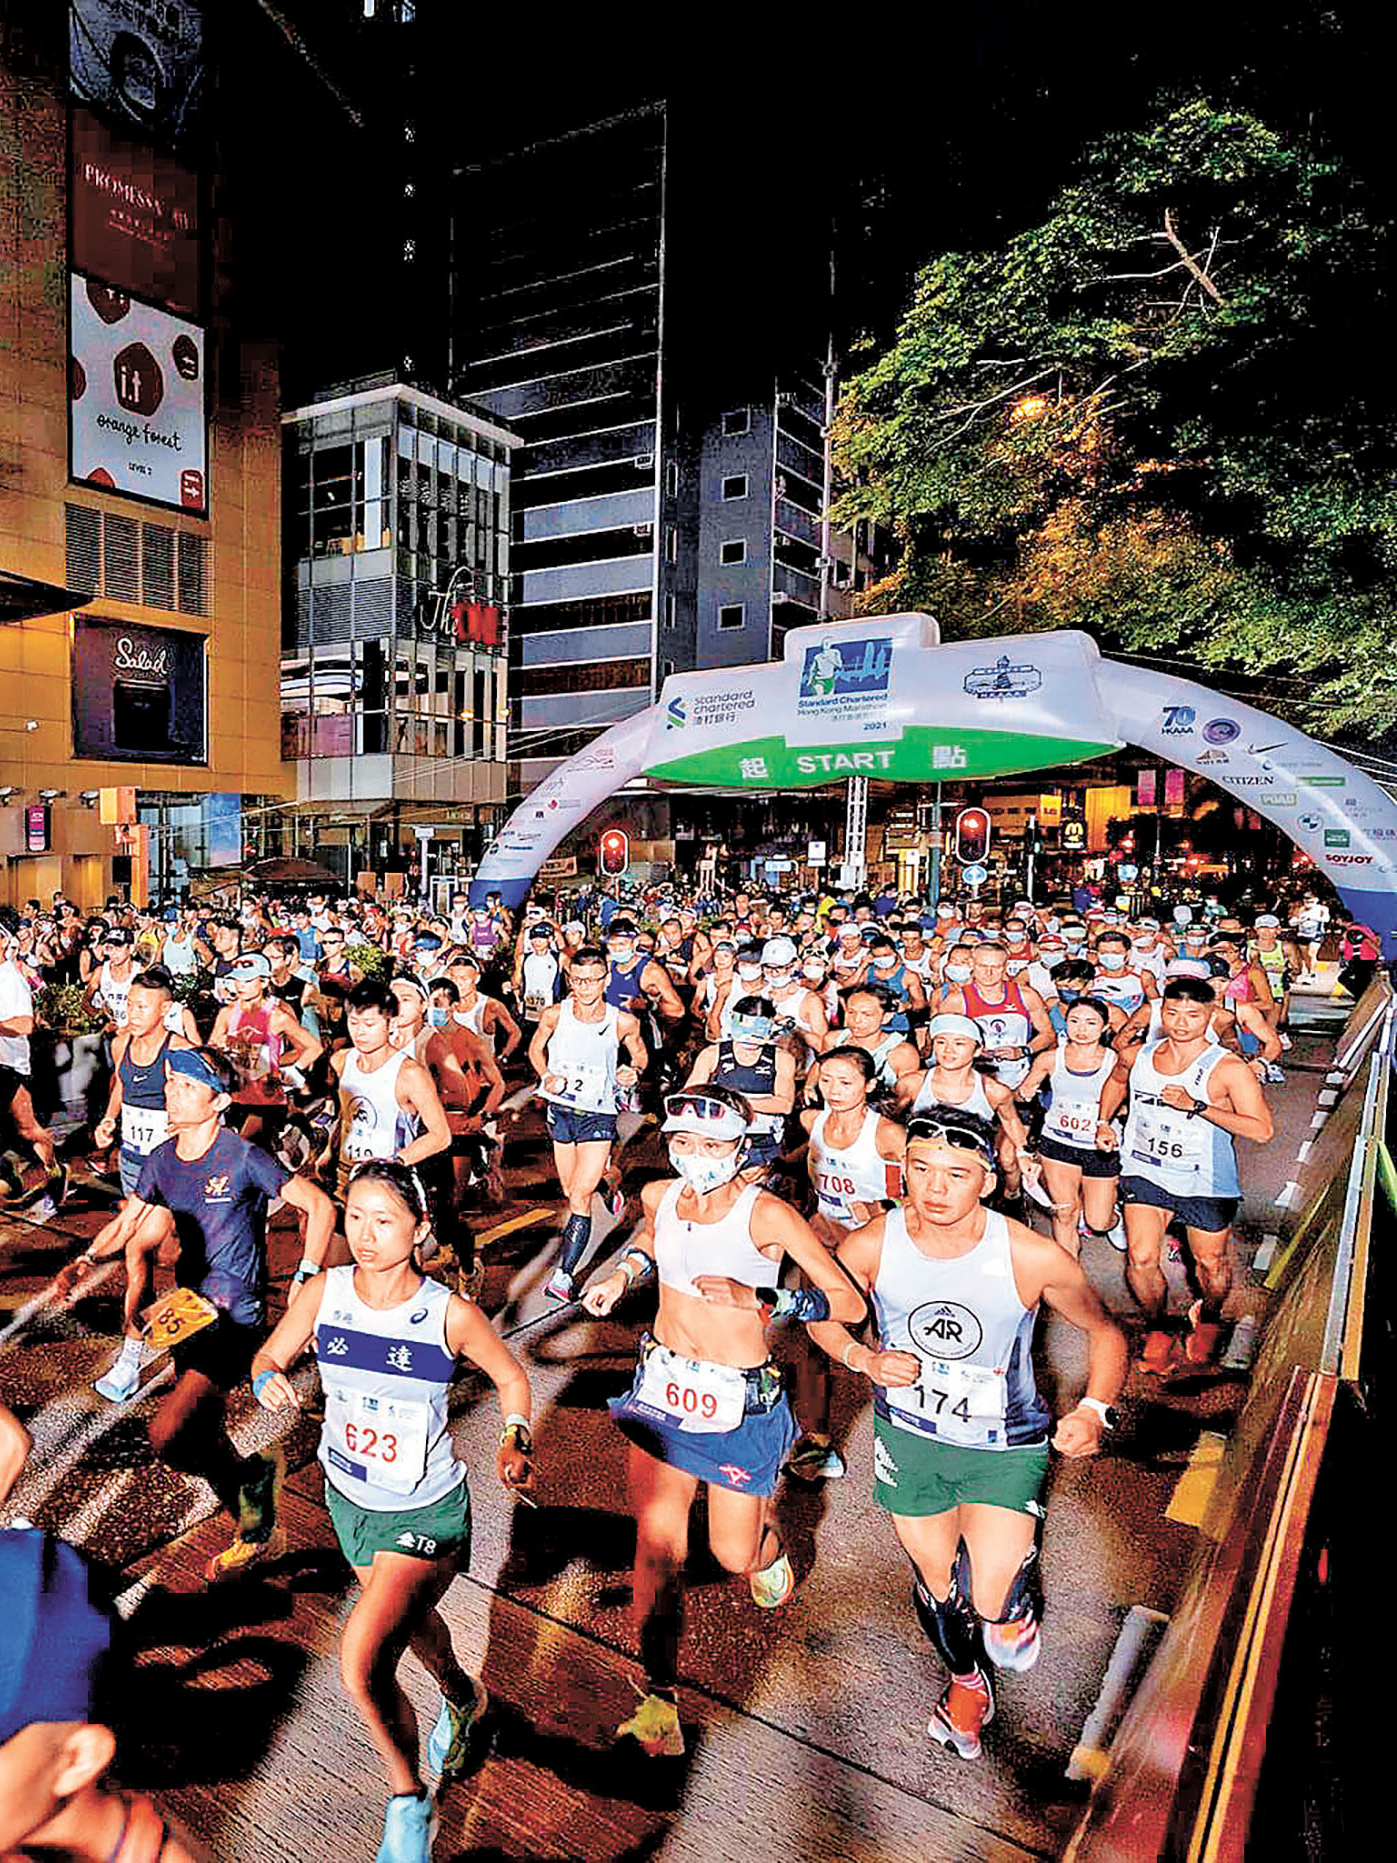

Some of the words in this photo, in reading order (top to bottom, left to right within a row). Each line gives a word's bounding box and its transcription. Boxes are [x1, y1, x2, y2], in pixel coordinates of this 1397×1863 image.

[97, 414, 140, 445] orange
[142, 423, 182, 451] forest
[115, 638, 167, 674] Salad
[694, 690, 753, 705] standard
[694, 699, 755, 714] chartered
[798, 697, 839, 708] Standard
[840, 692, 888, 704] Chartered
[863, 721, 887, 730] 2021
[1163, 706, 1196, 727] 70
[739, 757, 769, 779] 起
[797, 750, 896, 773] START
[932, 744, 968, 770] 點
[1222, 776, 1275, 785] CITIZEN
[1325, 854, 1374, 864] SOYJOY
[1059, 1114, 1092, 1131] 602
[130, 1125, 154, 1142] 117
[1147, 1137, 1183, 1158] 156
[819, 1173, 855, 1194] 708
[665, 1382, 718, 1419] 609
[914, 1385, 973, 1423] 174
[345, 1422, 398, 1463] 623
[416, 1534, 437, 1555] T8
